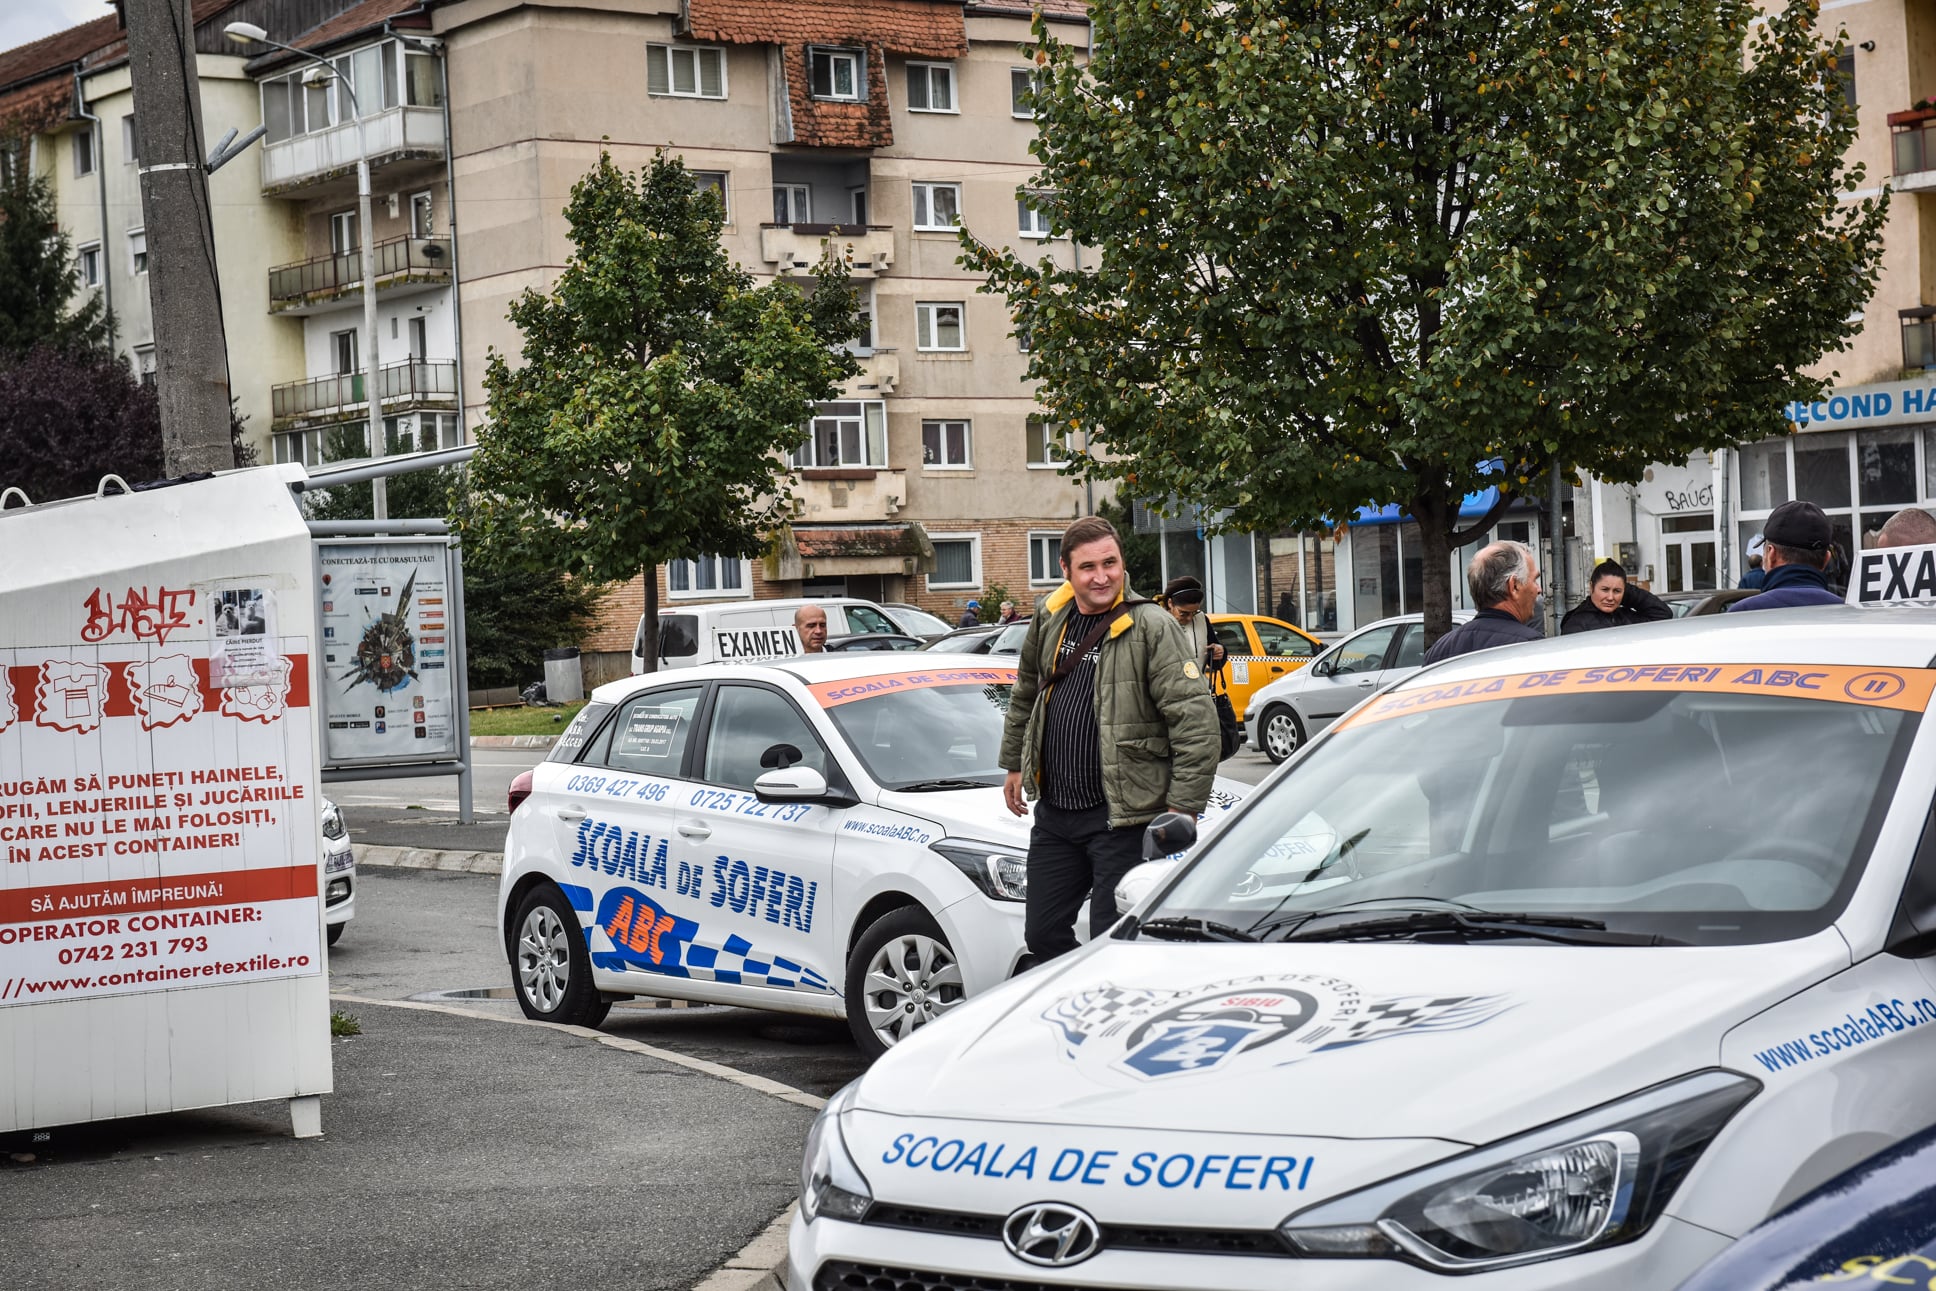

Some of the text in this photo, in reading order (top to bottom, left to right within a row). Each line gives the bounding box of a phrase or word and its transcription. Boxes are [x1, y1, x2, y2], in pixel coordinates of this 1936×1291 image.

[379, 557, 390, 565] CU
[1859, 550, 1936, 602] EXA
[718, 630, 797, 657] EXAMEN
[827, 679, 904, 701] SCOALA
[907, 674, 934, 685] DE
[935, 672, 1000, 681] SOFERI
[1373, 678, 1504, 716] SCOALA
[1518, 671, 1569, 690] DE
[1577, 667, 1722, 685] SOFERI
[1731, 669, 1829, 690] ABC
[0, 765, 283, 797] UGĂM SĂ PUNEȚI HAINELE,
[567, 774, 670, 802] 0369 427 496
[47, 794, 167, 816] LENJERIILE
[174, 792, 192, 811] ȘI
[200, 785, 304, 806] JUCĂRIILE
[690, 789, 732, 811] 0725
[735, 796, 769, 817] 722
[0, 809, 276, 842] CARE NU LE MAI FOLOSIȚI,
[844, 820, 930, 844] www.scoalaABC.ro
[8, 832, 240, 864] ÎN ACEST CONTAINER!
[571, 818, 818, 933] SCOALA DE SOFERI
[31, 881, 223, 912] SĂ AJUTĂM ÎMPREUNĂ!
[0, 907, 262, 944] OPERATOR CONTAINER:
[606, 895, 675, 965] ABC
[58, 936, 208, 965] 0742 231 793
[1220, 997, 1285, 1008] SIBIU
[1753, 998, 1936, 1073] www.scoalaABC.ro
[882, 1133, 1315, 1191] SCOALA DE SOFERI
